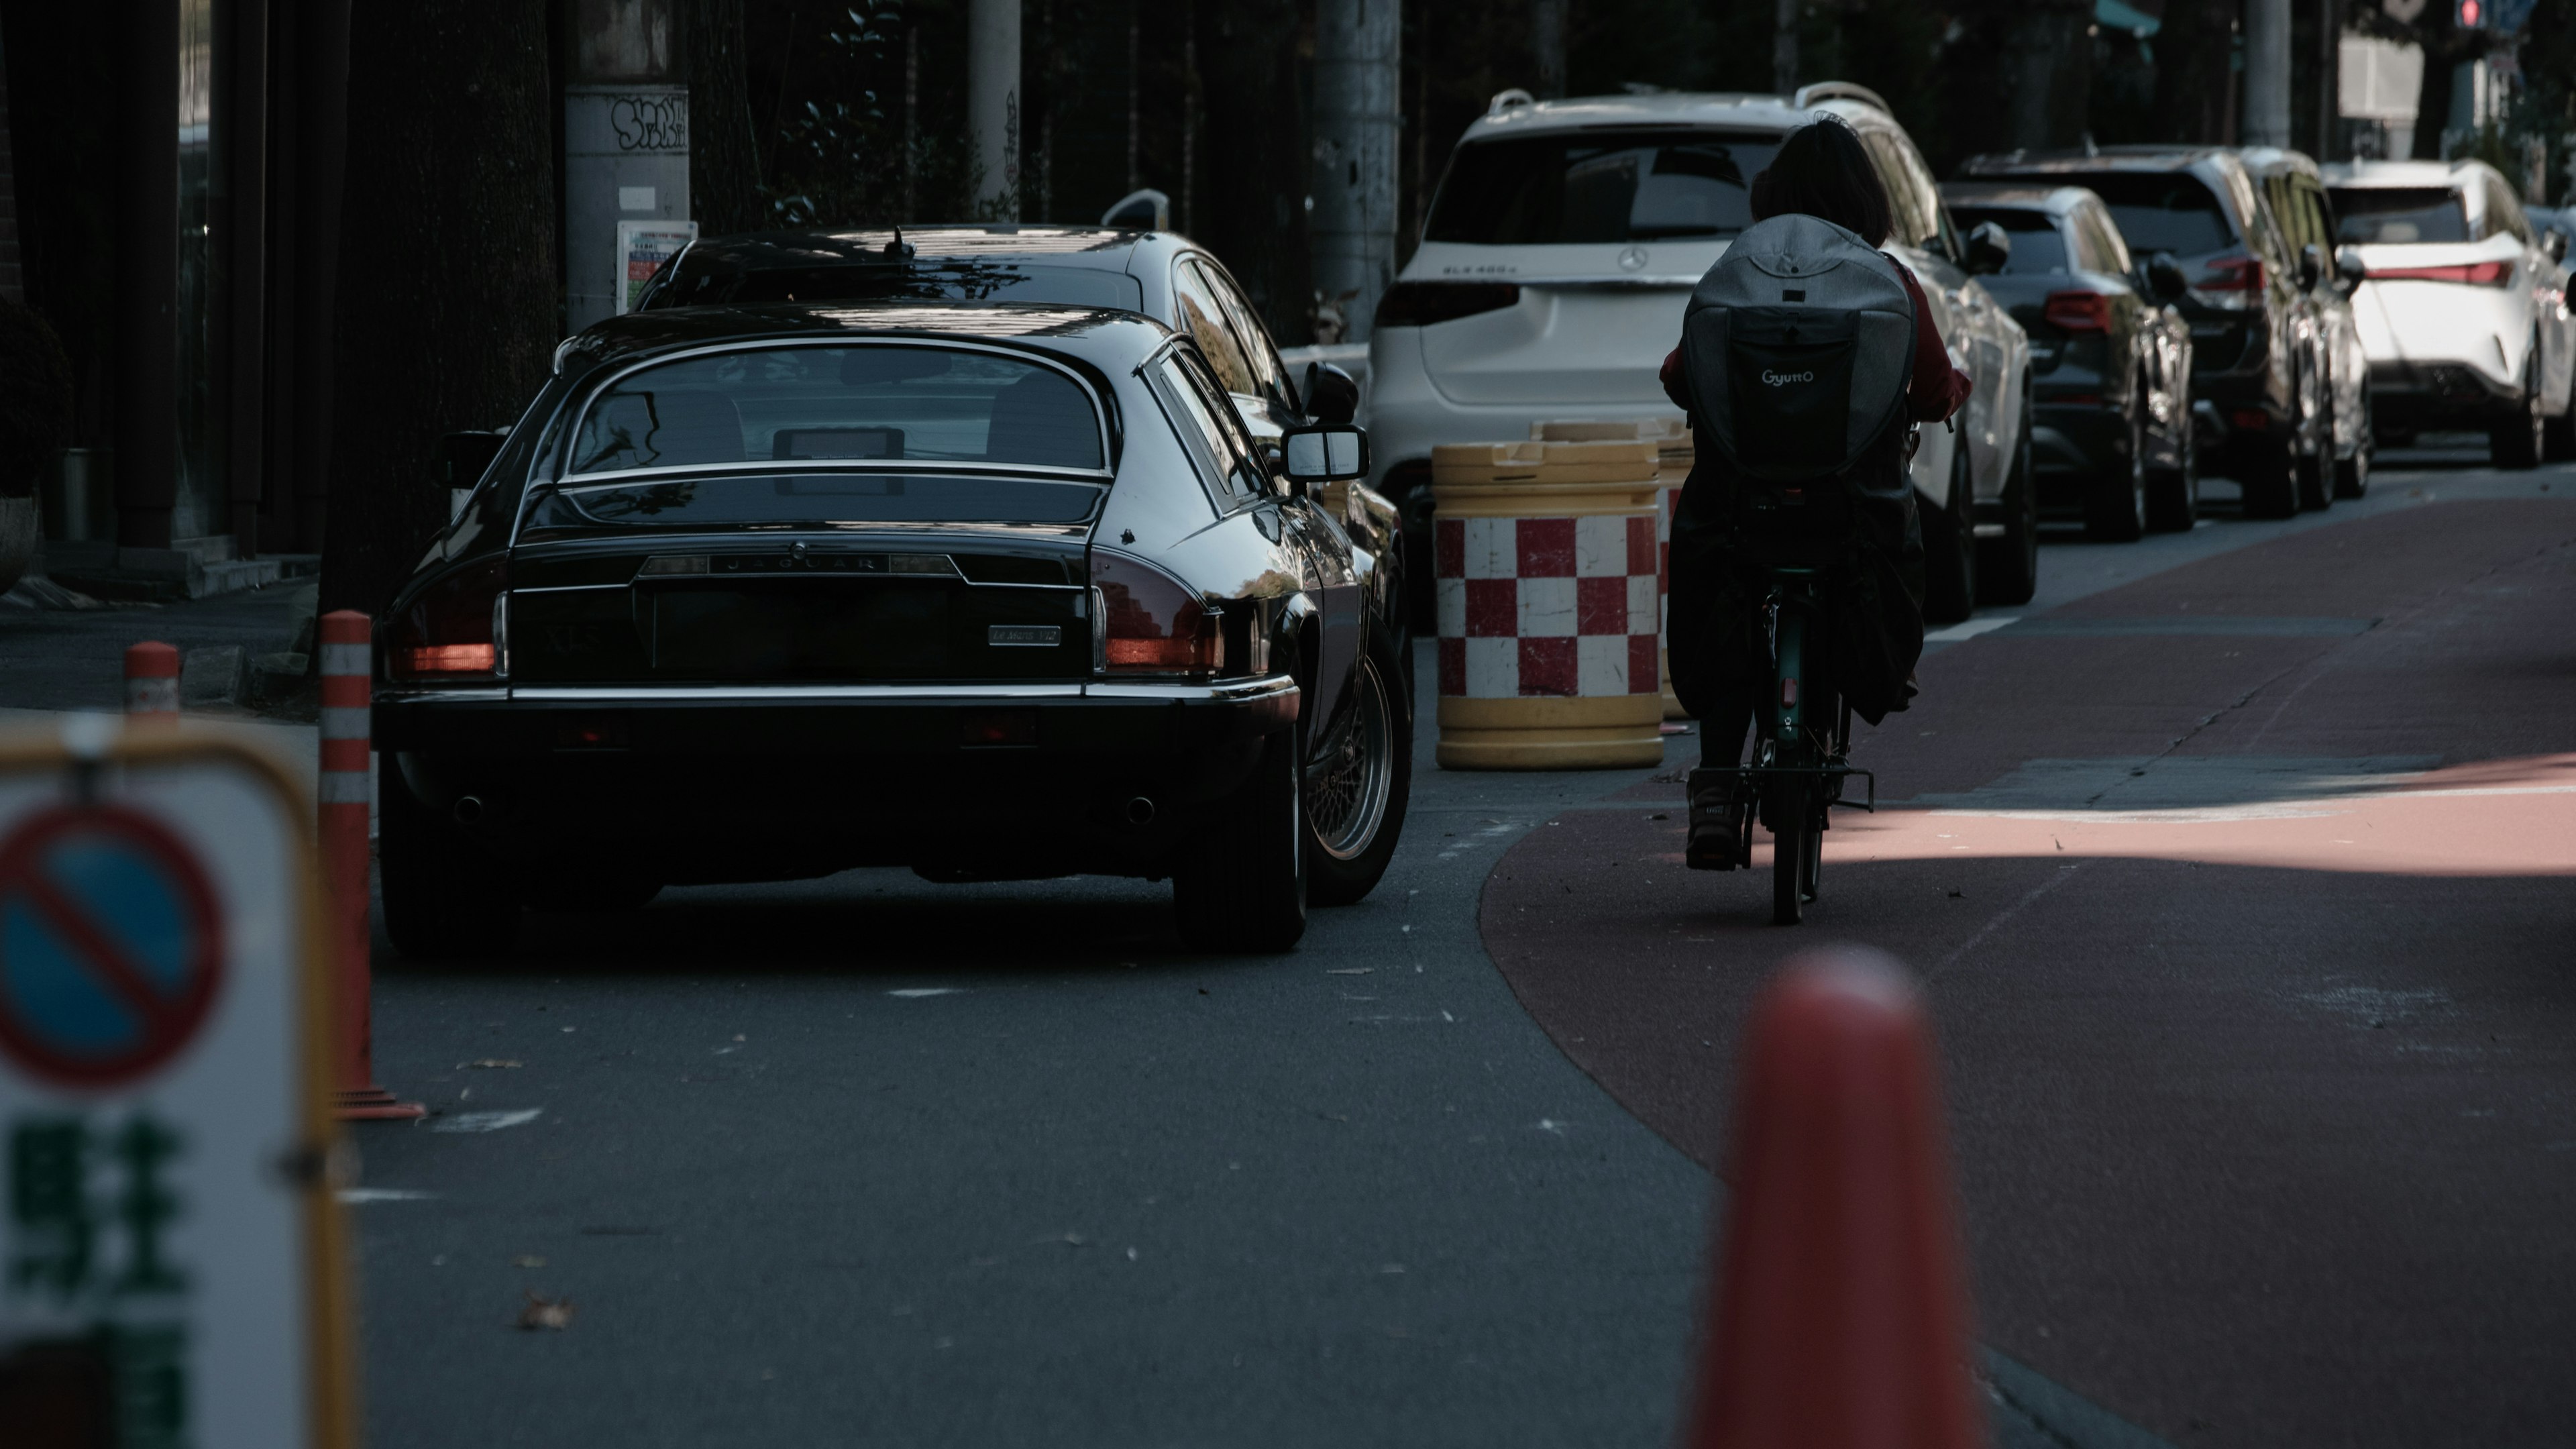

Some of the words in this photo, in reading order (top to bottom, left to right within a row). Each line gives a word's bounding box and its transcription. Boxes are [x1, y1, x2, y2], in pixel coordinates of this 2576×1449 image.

[728, 558, 874, 570] JAGUAR
[993, 630, 1004, 640] Le
[1007, 630, 1034, 641] Mans
[1039, 631, 1056, 641] V12
